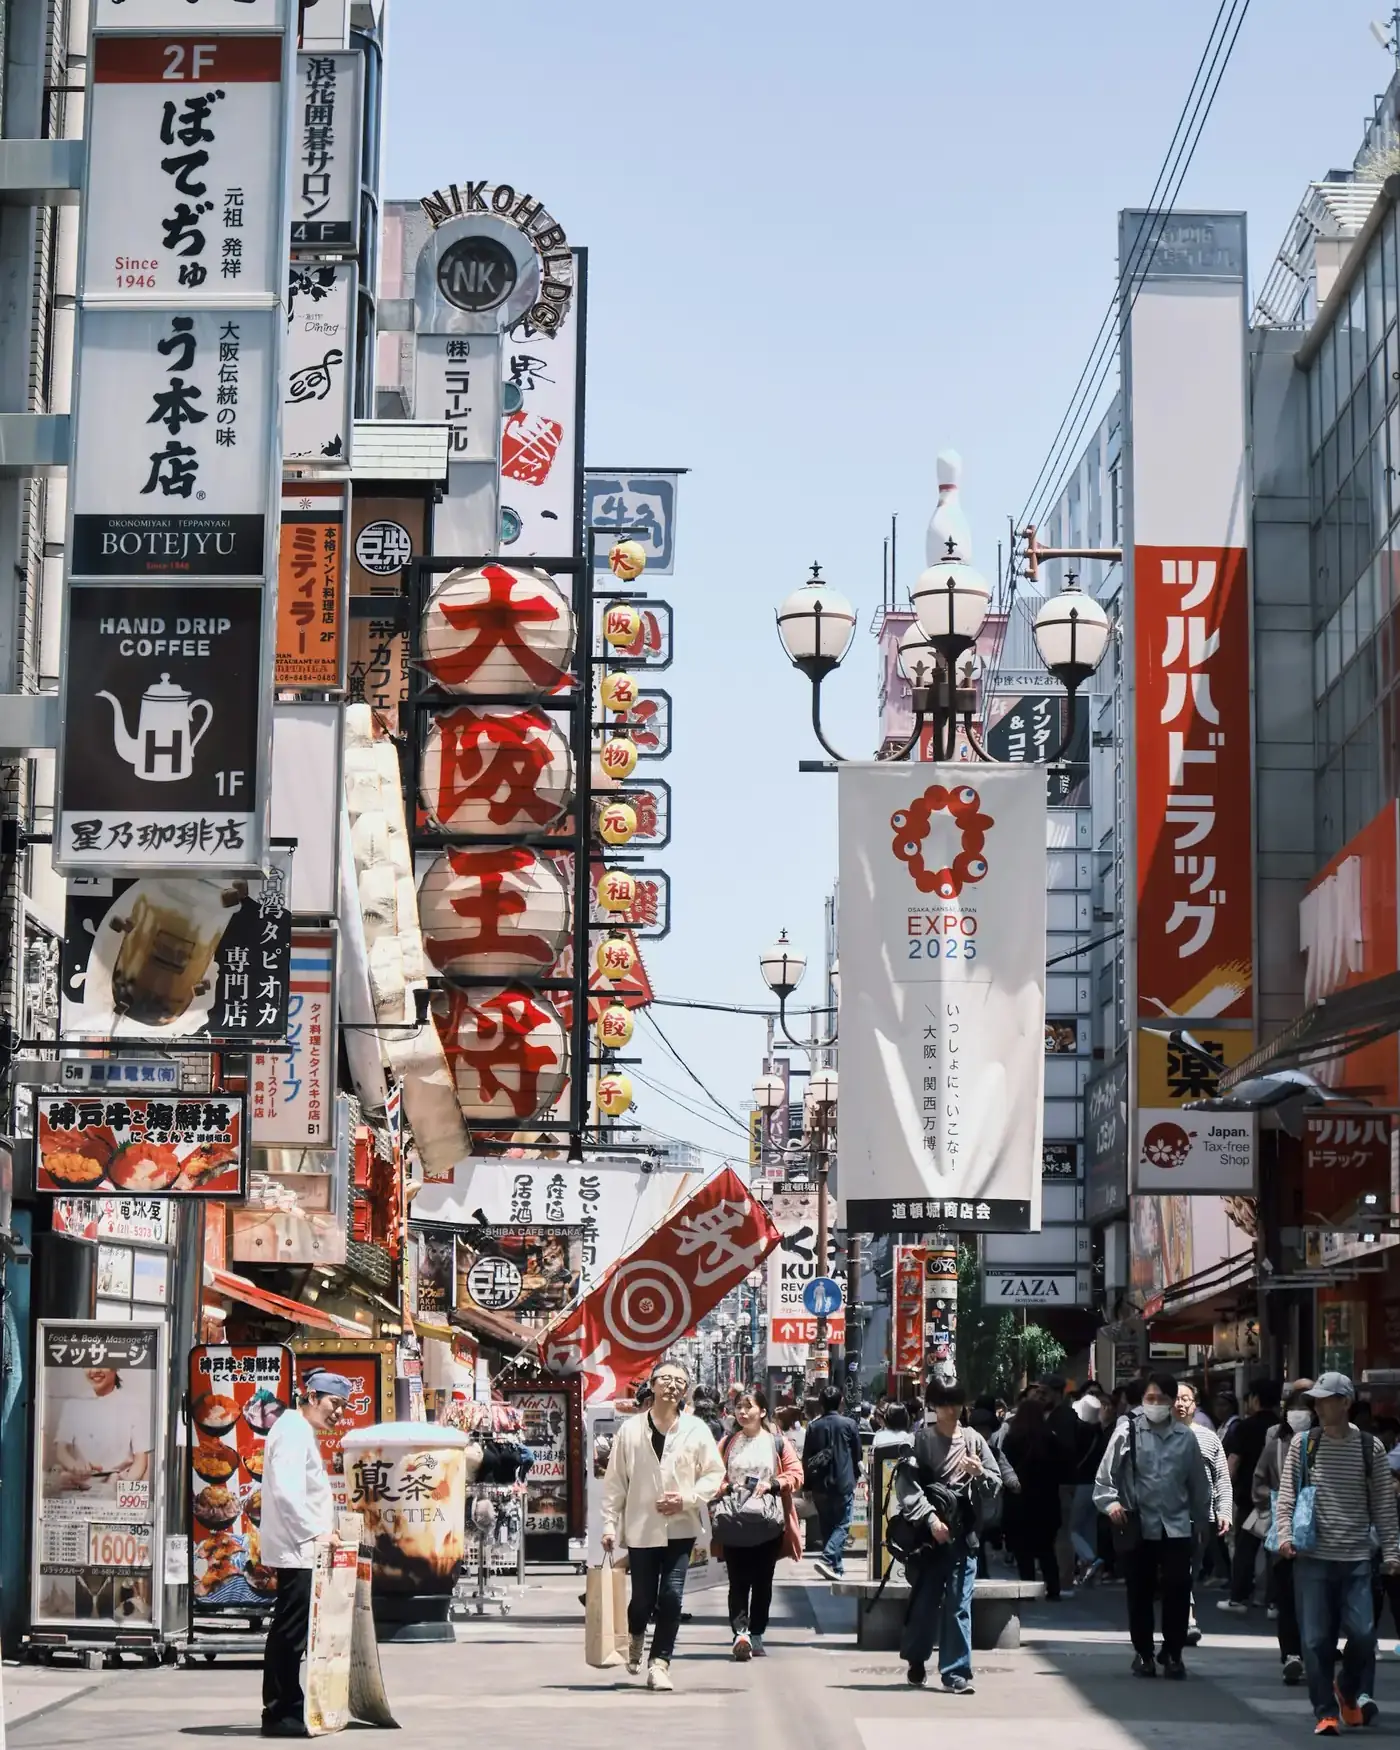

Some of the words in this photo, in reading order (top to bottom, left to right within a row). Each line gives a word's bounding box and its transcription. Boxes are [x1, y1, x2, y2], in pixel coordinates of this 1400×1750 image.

[162, 45, 217, 80] 2F
[302, 57, 336, 219] 浪花囲碁サロン
[160, 90, 225, 288] ぼてぢゅ
[223, 188, 243, 228] 元祖
[420, 181, 543, 228] NIKOH
[293, 223, 335, 241] 4F
[115, 257, 158, 269] Since
[221, 238, 242, 279] 発祥
[116, 276, 156, 288] 1946
[452, 261, 497, 294] NK
[305, 322, 339, 336] Dining
[216, 321, 240, 447] 大阪伝統の味
[140, 317, 208, 498] う本店
[101, 532, 236, 558] BOTEJYU
[322, 527, 337, 624] 本格インド料理店
[290, 527, 317, 654] ミティラー
[100, 618, 165, 634] HAND
[175, 618, 231, 634] DRIP
[320, 632, 335, 642] 2F
[119, 639, 210, 656] COFFEE
[1160, 560, 1226, 959] ツルハドラッグ
[215, 771, 244, 797] 1F
[71, 818, 248, 855] 星乃珈琲店
[908, 916, 977, 936] EXPO
[909, 939, 977, 959] 2025
[222, 947, 250, 1027] 専門店
[308, 1003, 322, 1121] タイ料理とタイスキの店
[49, 1102, 231, 1131] 神戸牛と海鮮丼
[130, 1131, 195, 1143] にくあんど
[308, 1124, 320, 1134] B1
[1207, 1126, 1249, 1138] Japan.
[1308, 1120, 1388, 1145] ツルハ
[1203, 1141, 1250, 1152] Tax-free
[1219, 1154, 1250, 1166] Shop
[1308, 1151, 1373, 1168] ドラッグ
[892, 1203, 991, 1220] 道頓堀商店会
[1001, 1280, 1059, 1296] ZAZA
[49, 1334, 67, 1342] Foot
[81, 1335, 102, 1344] Body
[105, 1336, 141, 1345] Massage
[49, 1344, 148, 1366] マッサージ
[129, 1482, 148, 1491] 15分
[120, 1495, 148, 1507] 990円
[404, 1508, 445, 1522] TEA
[129, 1525, 149, 1536] 30分
[92, 1534, 149, 1564] 1600円
